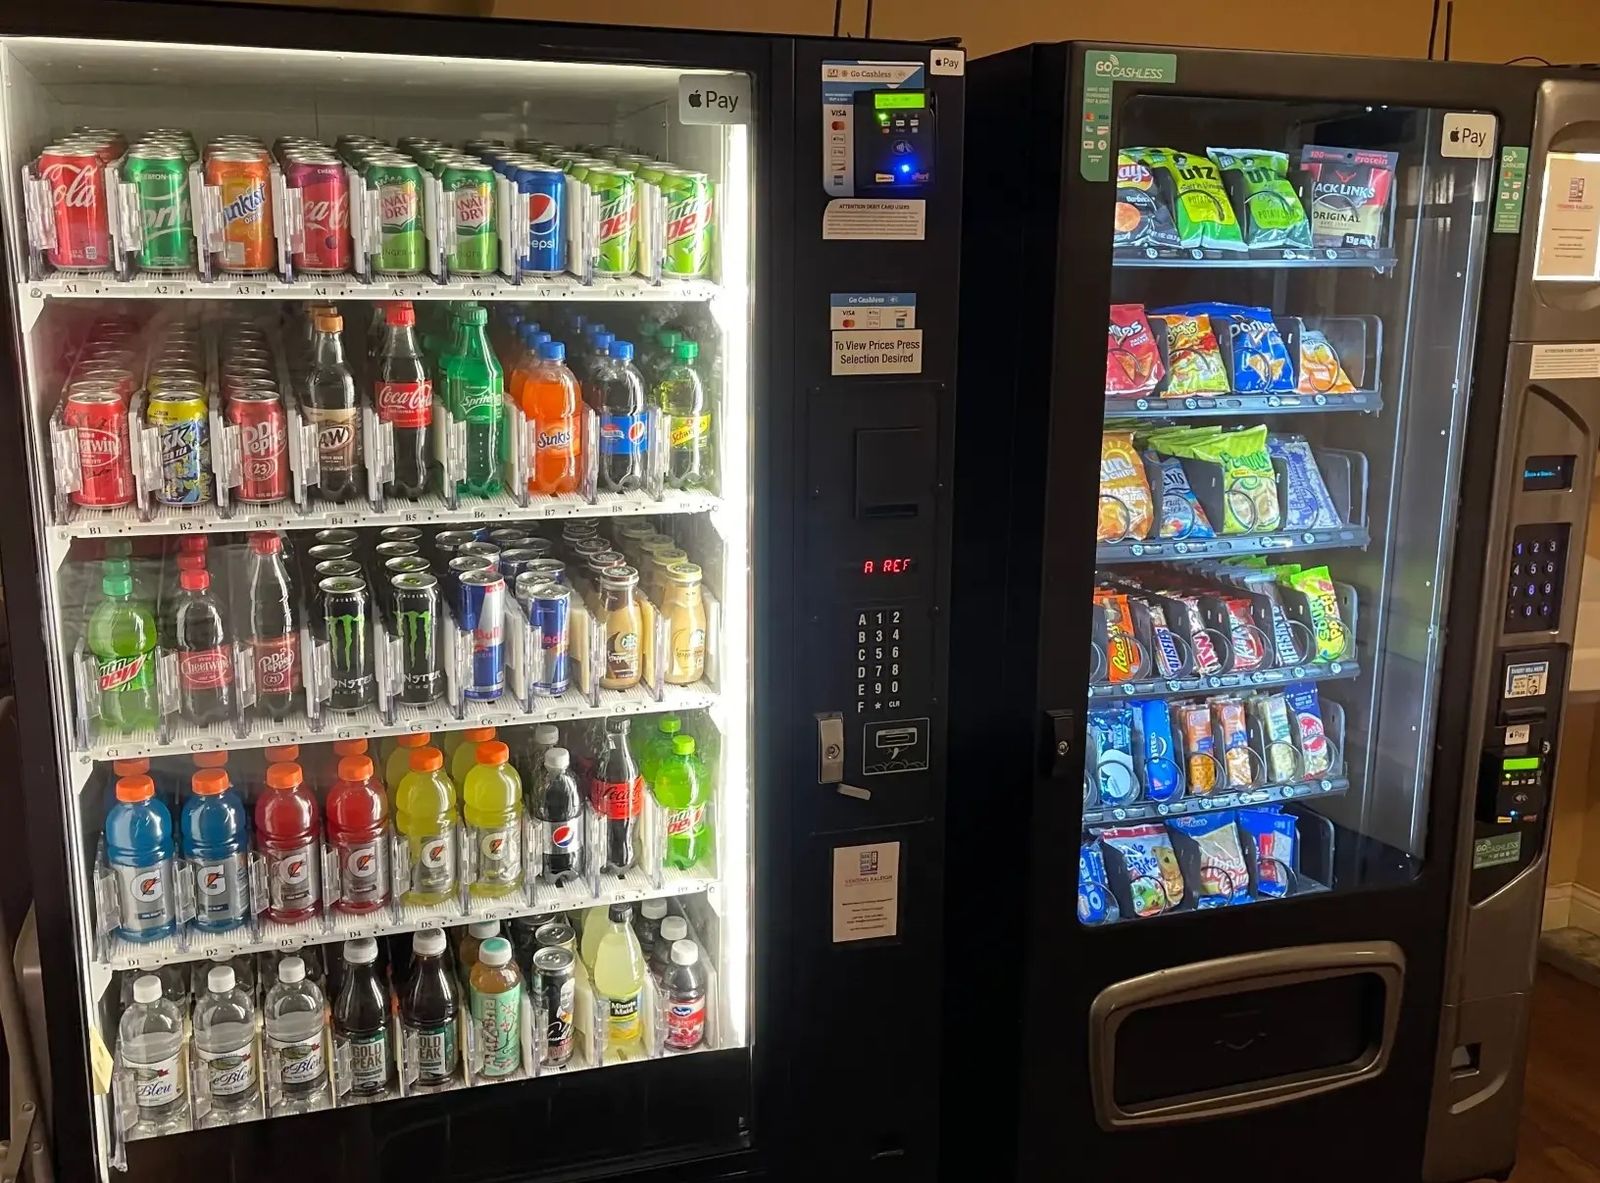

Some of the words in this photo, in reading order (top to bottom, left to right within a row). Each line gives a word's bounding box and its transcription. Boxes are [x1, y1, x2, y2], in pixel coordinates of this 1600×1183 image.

[943, 58, 959, 70] Pay
[1112, 66, 1163, 79] CASHLESS
[705, 91, 739, 114] Pay
[1462, 128, 1486, 148] Pay
[223, 182, 266, 226] unkist
[385, 204, 408, 220] DRY
[461, 208, 483, 222] DRY
[530, 239, 556, 251] epsi
[64, 284, 78, 293] A1
[154, 286, 168, 294] A2
[236, 286, 250, 296] A3
[313, 287, 327, 296] A4
[391, 289, 404, 298] A5
[469, 289, 482, 297] A6
[539, 289, 551, 298] A7
[613, 289, 625, 297] A8
[835, 341, 844, 350] To
[846, 341, 866, 350] View
[869, 340, 894, 350] Prices
[897, 340, 920, 350] Press
[840, 354, 879, 364] Selection
[882, 353, 913, 363] Desired
[253, 463, 266, 474] 23
[89, 527, 101, 535] B1
[180, 522, 192, 530] B2
[332, 518, 343, 526] B4
[1517, 543, 1523, 554] 1
[1533, 542, 1539, 553] 2
[1550, 541, 1556, 552] 3
[864, 561, 874, 573] A
[883, 558, 911, 573] REF
[1514, 565, 1520, 575] 4
[1531, 563, 1537, 574] 5
[1547, 562, 1553, 572] 6
[1512, 586, 1518, 597] 7
[1529, 585, 1535, 595] 8
[1545, 583, 1551, 593] 9
[1526, 606, 1532, 616] 0
[859, 614, 866, 626] A
[876, 613, 882, 624] 1
[893, 612, 900, 623] 2
[859, 632, 866, 643] B
[876, 631, 883, 642] 3
[892, 629, 899, 640] 4
[858, 649, 866, 660] C
[876, 648, 882, 659] 5
[892, 647, 899, 658] 6
[858, 667, 865, 678] D
[875, 666, 882, 677] 7
[892, 664, 899, 675] 8
[858, 684, 864, 696] E
[875, 683, 882, 694] 9
[892, 682, 898, 693] 0
[858, 702, 864, 713] F
[191, 743, 204, 751] C2
[268, 736, 280, 744] C3
[338, 731, 350, 739] C4
[410, 724, 422, 732] C5
[481, 718, 493, 726] C6
[1515, 730, 1525, 739] Pay
[128, 959, 140, 967] D1
[206, 948, 218, 956] D2
[281, 938, 294, 946] D3
[350, 930, 362, 938] D4
[419, 1035, 440, 1048] OLD
[353, 1042, 382, 1057] GOLD
[419, 1046, 441, 1060] EAK
[352, 1053, 382, 1069] PEAK
[139, 1081, 172, 1097] Bleu
